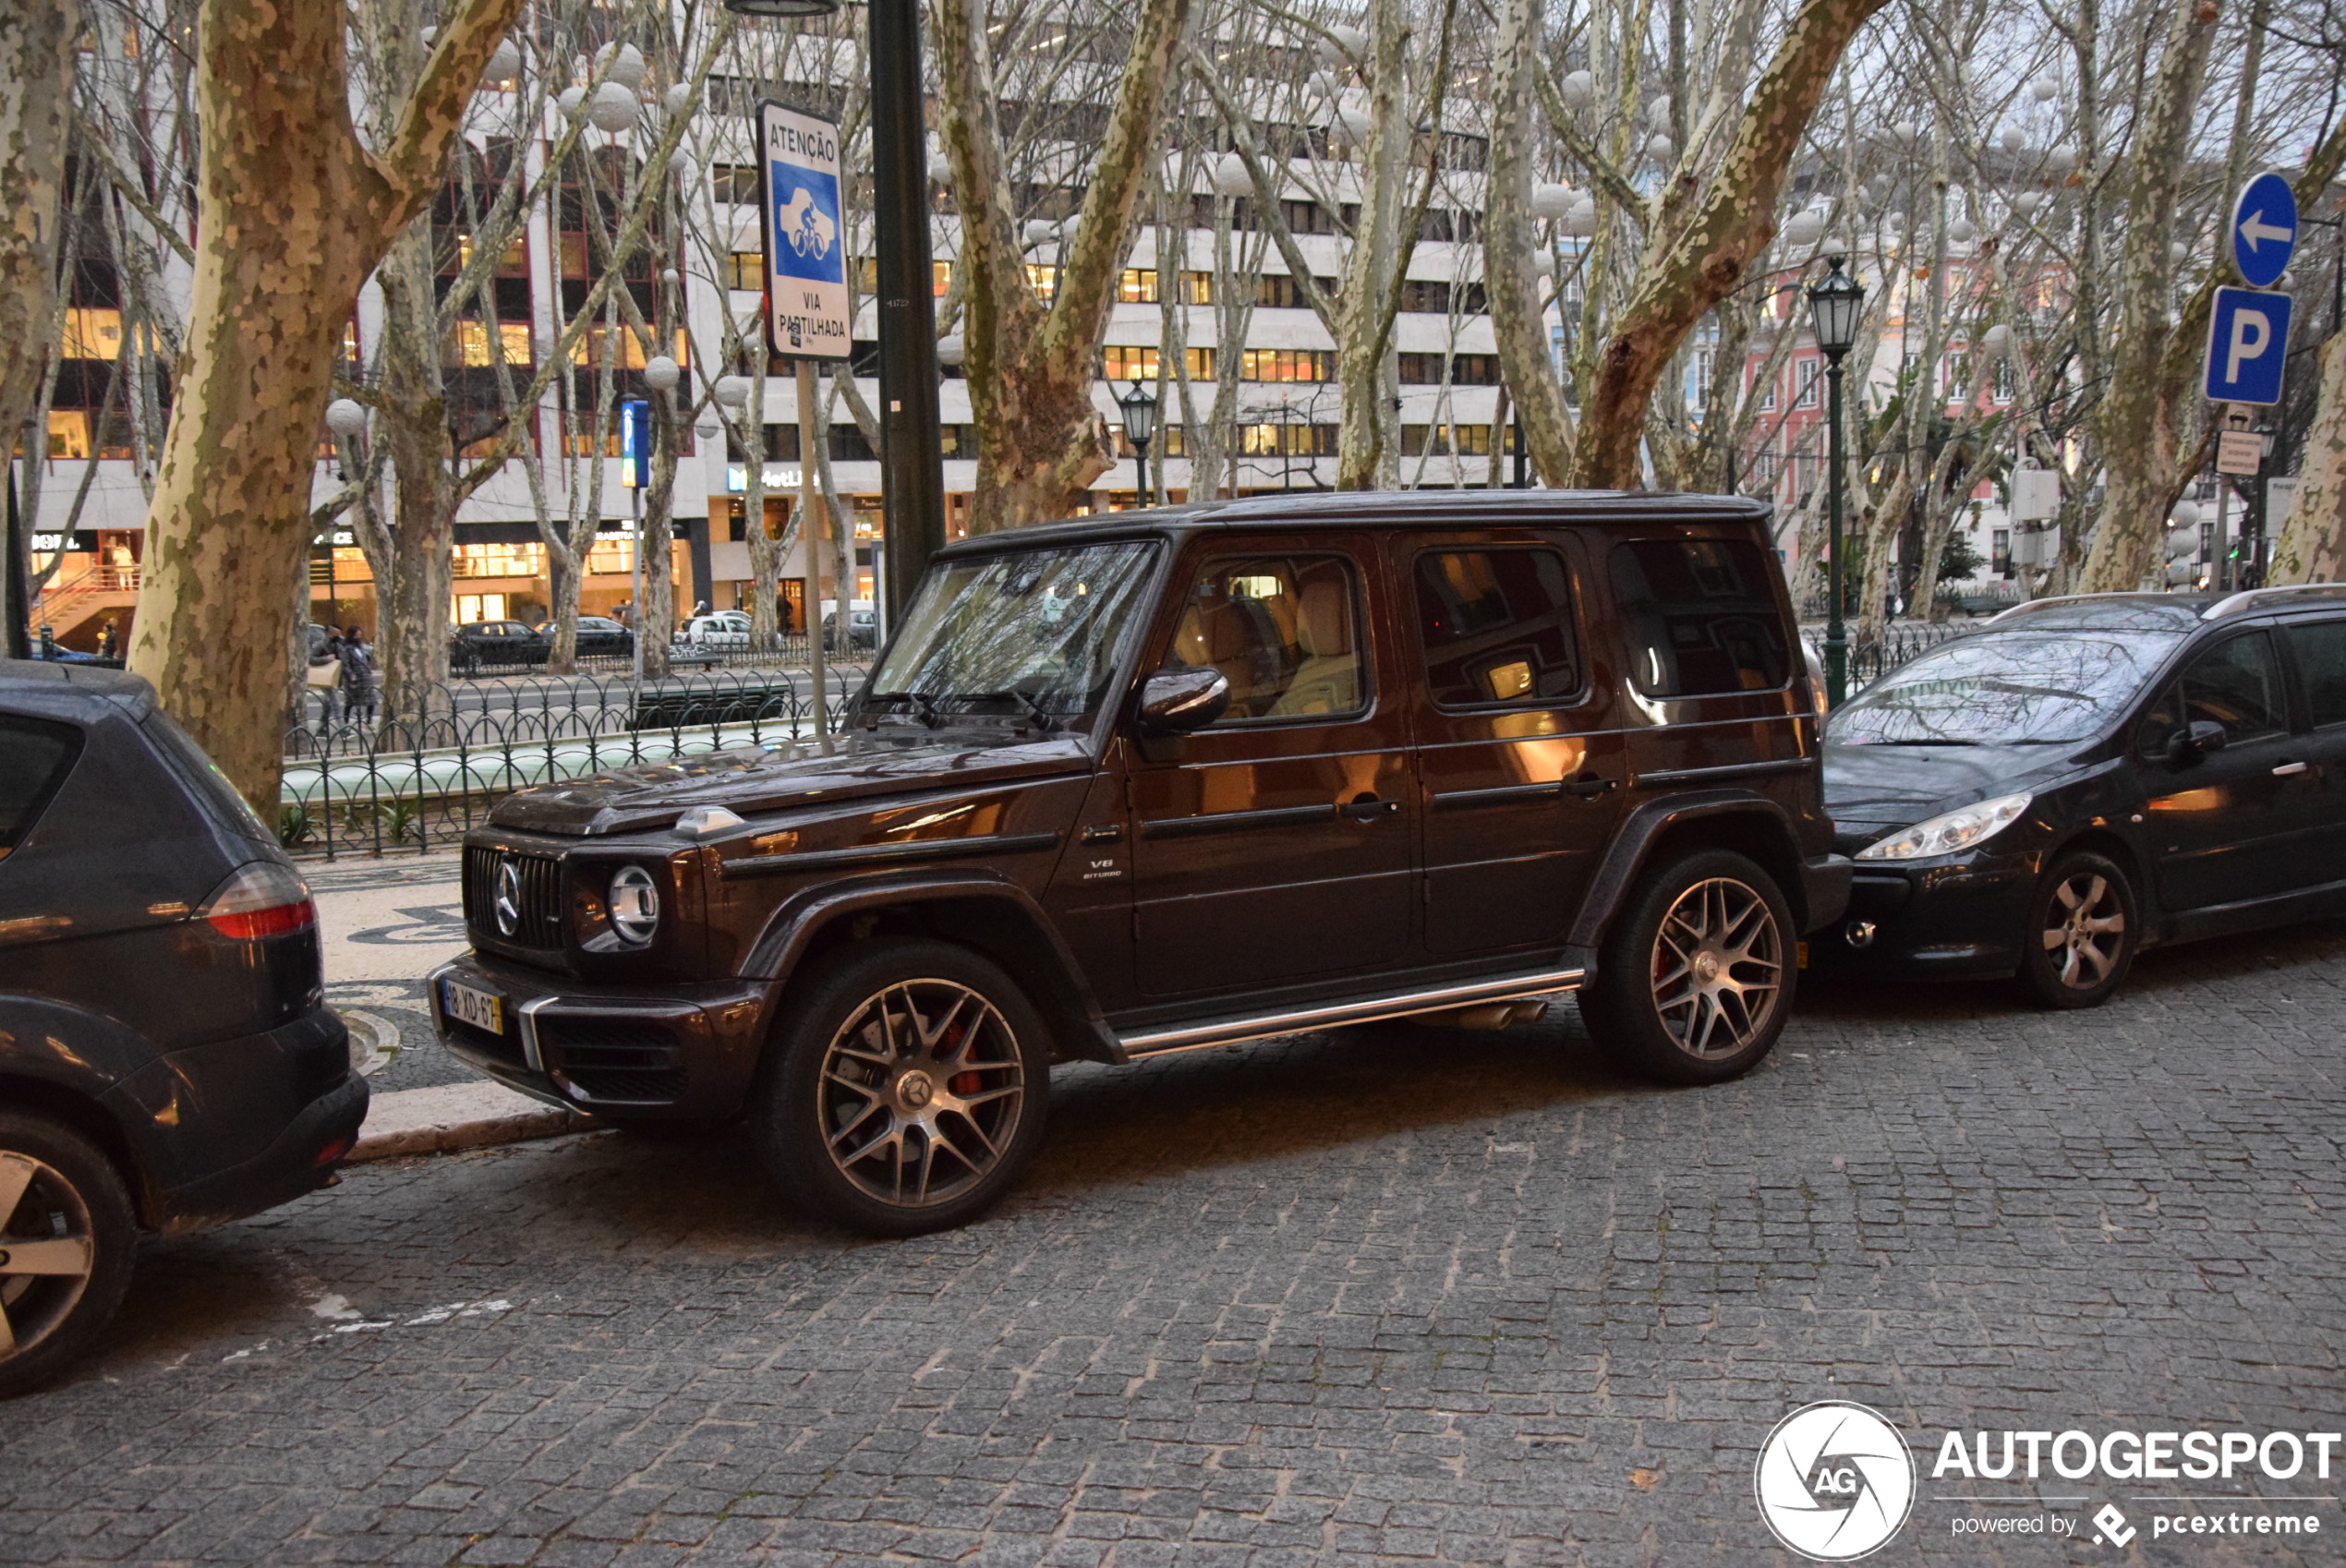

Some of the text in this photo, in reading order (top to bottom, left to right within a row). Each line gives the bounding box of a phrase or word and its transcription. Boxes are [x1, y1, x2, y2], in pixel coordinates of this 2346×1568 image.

[770, 123, 835, 163] ATENÇÃO
[803, 291, 821, 311] VIA
[2225, 308, 2271, 384] P
[1090, 859, 1114, 869] V8
